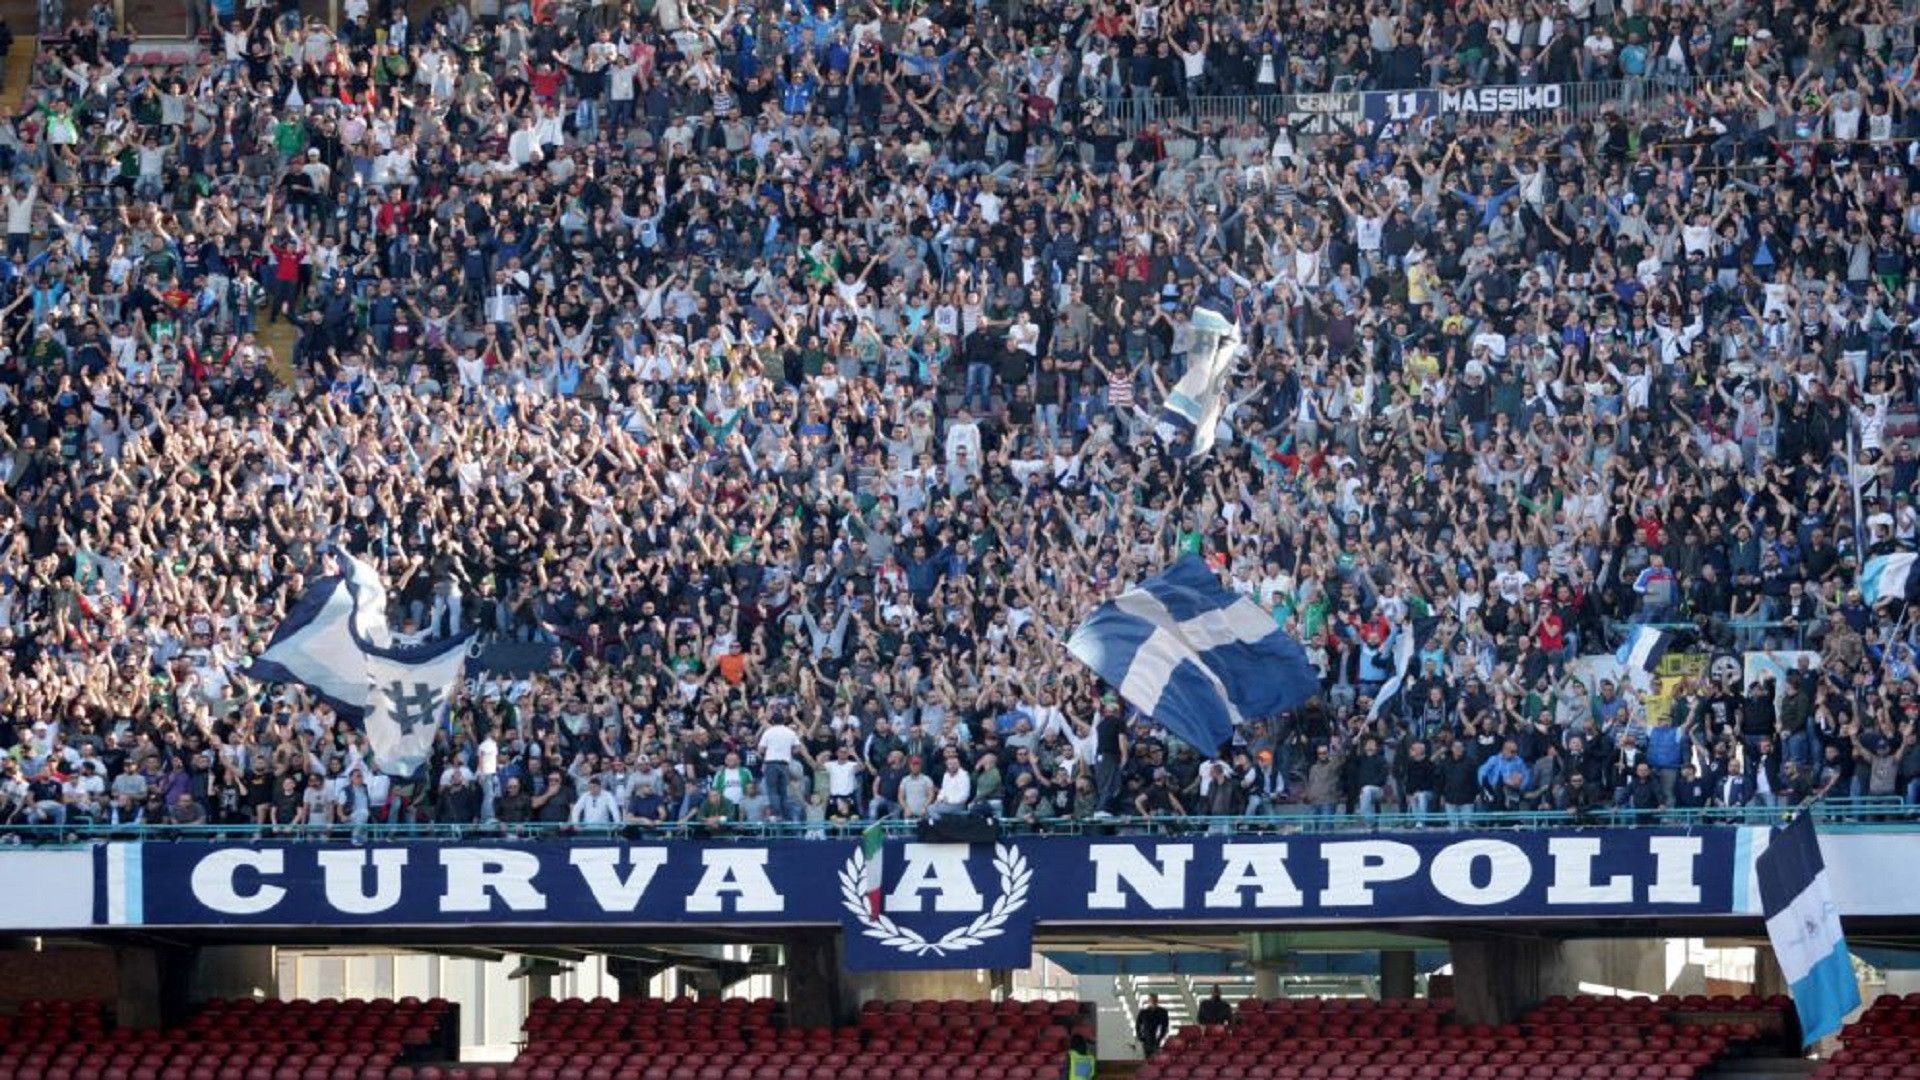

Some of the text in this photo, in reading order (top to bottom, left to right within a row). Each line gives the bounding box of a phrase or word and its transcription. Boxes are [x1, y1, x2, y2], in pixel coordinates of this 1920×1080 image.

[1443, 84, 1561, 112] MASSIMO
[191, 836, 1702, 915] CURVA A NAPOLI
